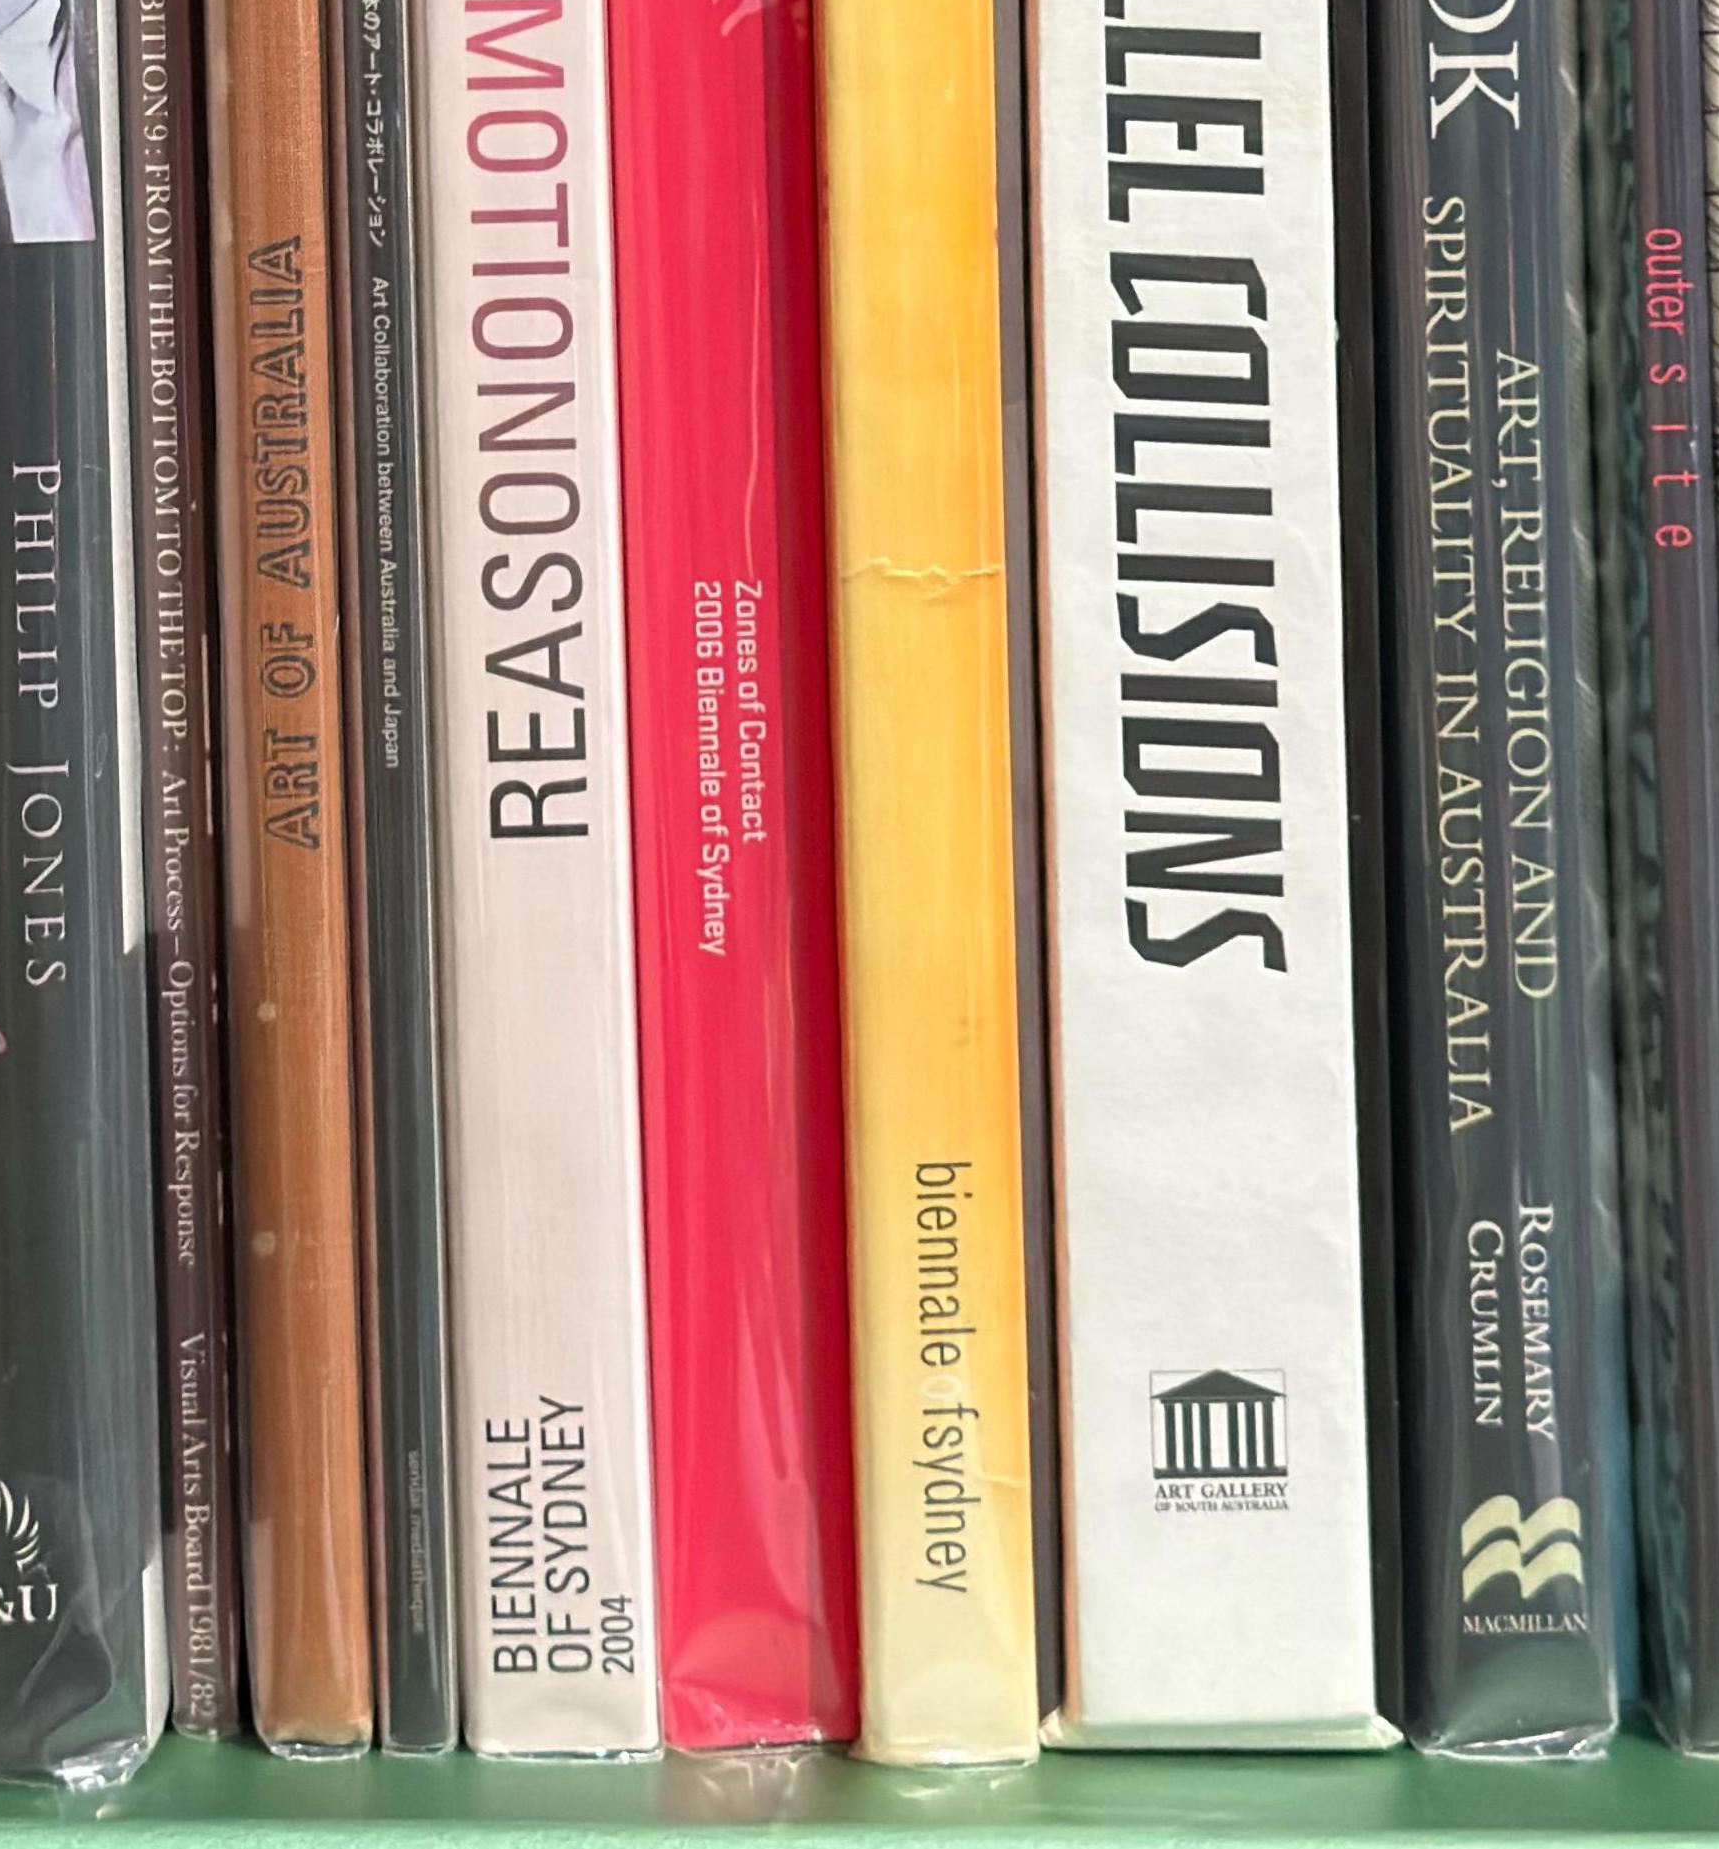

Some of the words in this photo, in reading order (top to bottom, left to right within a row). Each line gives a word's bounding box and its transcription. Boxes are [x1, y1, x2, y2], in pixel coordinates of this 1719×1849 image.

[144, 164, 174, 267] FROM
[148, 273, 177, 350] THE
[371, 276, 391, 309] Art
[1645, 228, 1693, 333] outer
[249, 234, 311, 590] AUSTRALIA
[373, 320, 394, 457] Collaboration
[1422, 194, 1479, 643] SPIRITUALITY
[1487, 350, 1543, 488] ART,
[149, 355, 182, 518] BOTTOM
[154, 528, 183, 577] TO
[375, 461, 397, 553] between
[157, 581, 186, 660] THE
[378, 558, 400, 653] Australia
[693, 580, 724, 659] 2006
[734, 579, 764, 674] Zones
[1109, 251, 1289, 973] COLLISIONS
[259, 621, 315, 698] OF
[382, 657, 402, 699] and
[737, 680, 766, 713] of
[1498, 506, 1554, 832] RELIGION
[381, 704, 403, 769] Japan
[697, 666, 728, 797] Biennale
[1435, 669, 1482, 752] IN
[162, 769, 189, 817] Art
[263, 726, 320, 850] ART
[700, 803, 730, 837] of
[739, 719, 768, 844] Contact
[163, 827, 192, 930] Process
[694, 842, 732, 957] Sydney
[1438, 763, 1493, 1135] AUSTRALIA
[1511, 854, 1560, 999] AND
[163, 959, 195, 1077] Options
[170, 1083, 199, 1118] for
[167, 1129, 202, 1267] Response
[917, 1161, 975, 1368] biennale
[179, 1333, 209, 1429] Visual
[181, 1434, 210, 1496] Arts
[539, 1394, 590, 1596] SYDNEY
[1154, 1482, 1195, 1500] ART
[1200, 1482, 1289, 1500] GALLERY
[184, 1504, 214, 1592] Board
[487, 1418, 538, 1674] BIENNALE
[545, 1613, 591, 1673] OF
[599, 1594, 635, 1675] 2004
[1462, 1614, 1588, 1634] MACMILLAN
